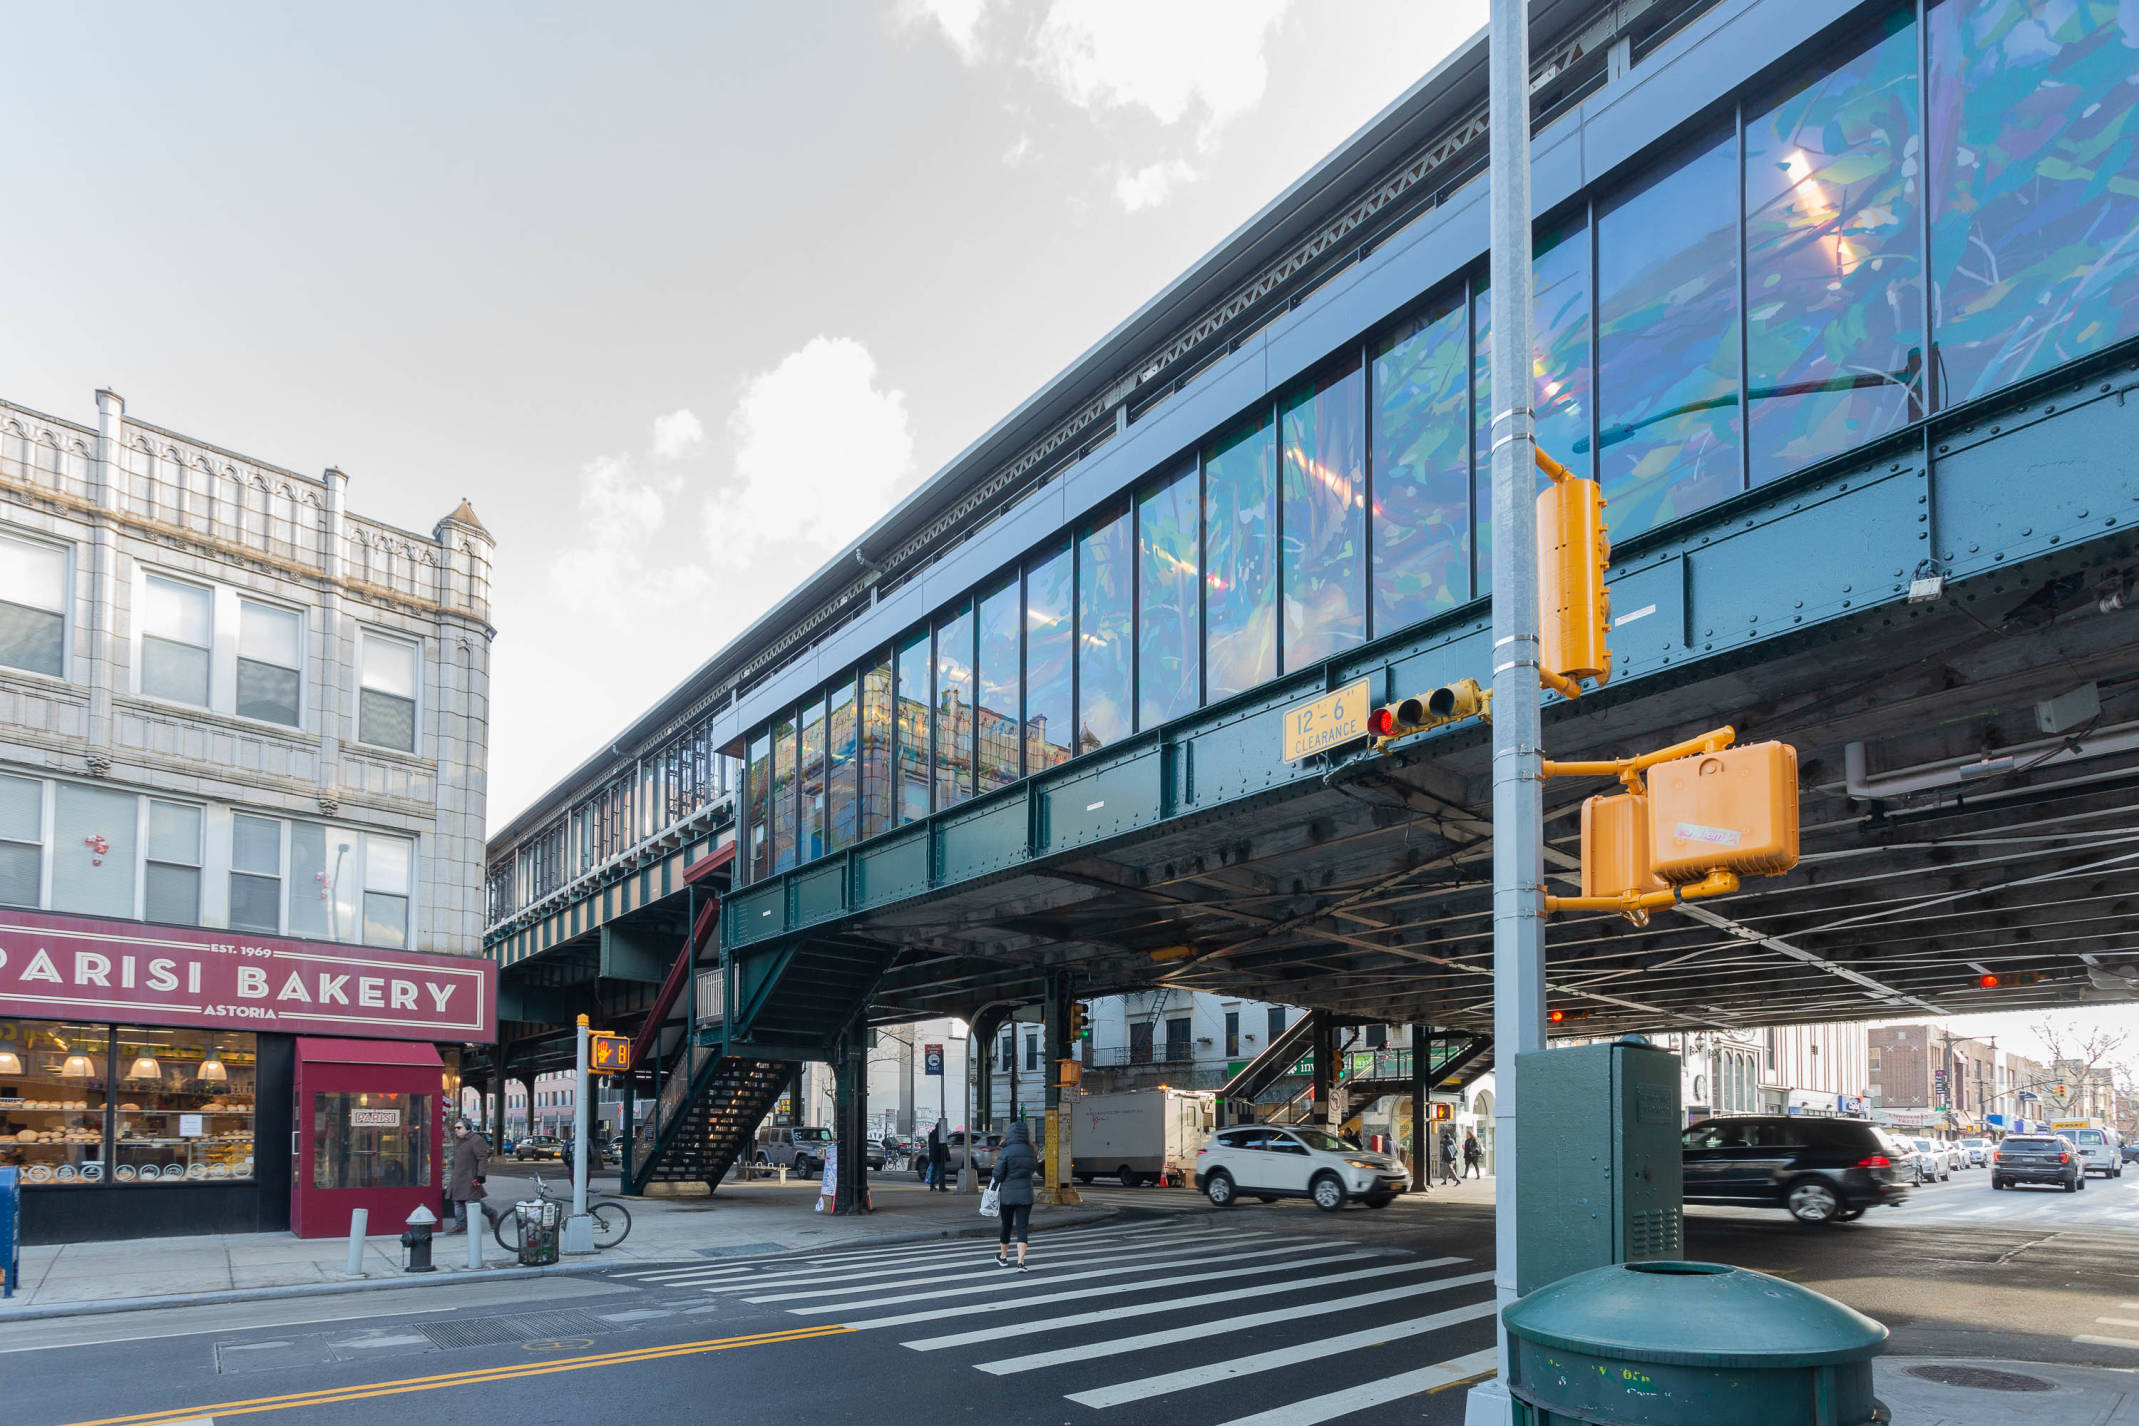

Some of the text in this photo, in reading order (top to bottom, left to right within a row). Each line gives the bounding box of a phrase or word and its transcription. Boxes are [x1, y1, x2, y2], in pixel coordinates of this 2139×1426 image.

[1295, 719, 1357, 754] CLEARANCE
[210, 943, 272, 959] EST. 1969
[0, 947, 457, 1013] ARISI BAKERY
[203, 1004, 277, 1020] ASTORIA
[618, 1044, 627, 1064] 8
[357, 1112, 396, 1122] PARISI
